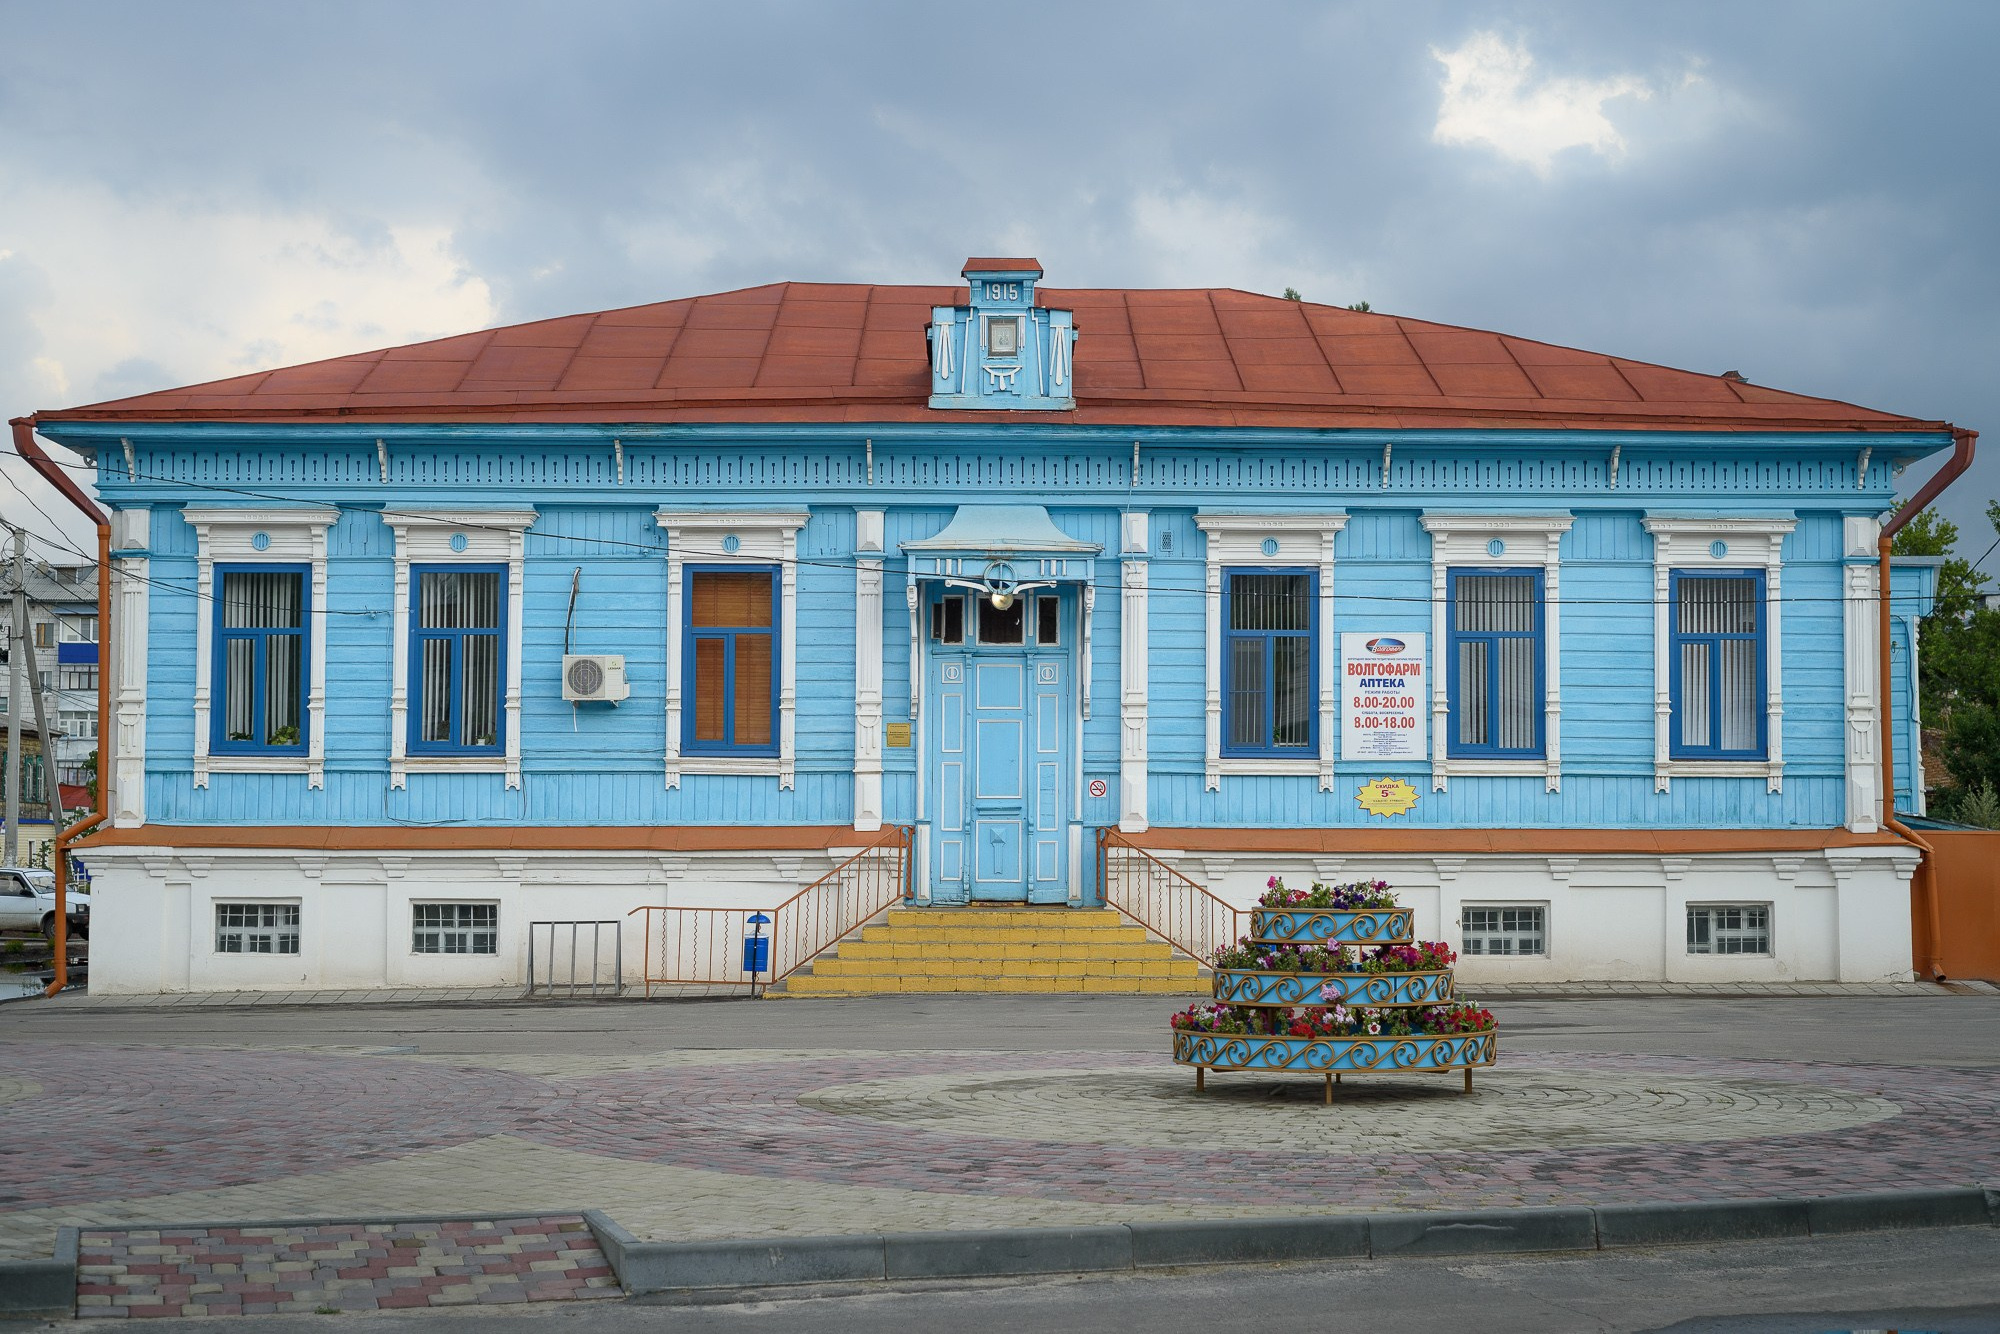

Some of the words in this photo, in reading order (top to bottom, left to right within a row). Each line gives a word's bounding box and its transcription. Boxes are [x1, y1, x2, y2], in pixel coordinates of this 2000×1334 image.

[986, 284, 1018, 300] 1915
[1347, 663, 1420, 676] ВОЛГОФАРМ
[1359, 679, 1405, 688] АПТЕКА
[1353, 696, 1415, 708] 8.00-20.00
[1354, 716, 1415, 728] 8.00-18.00
